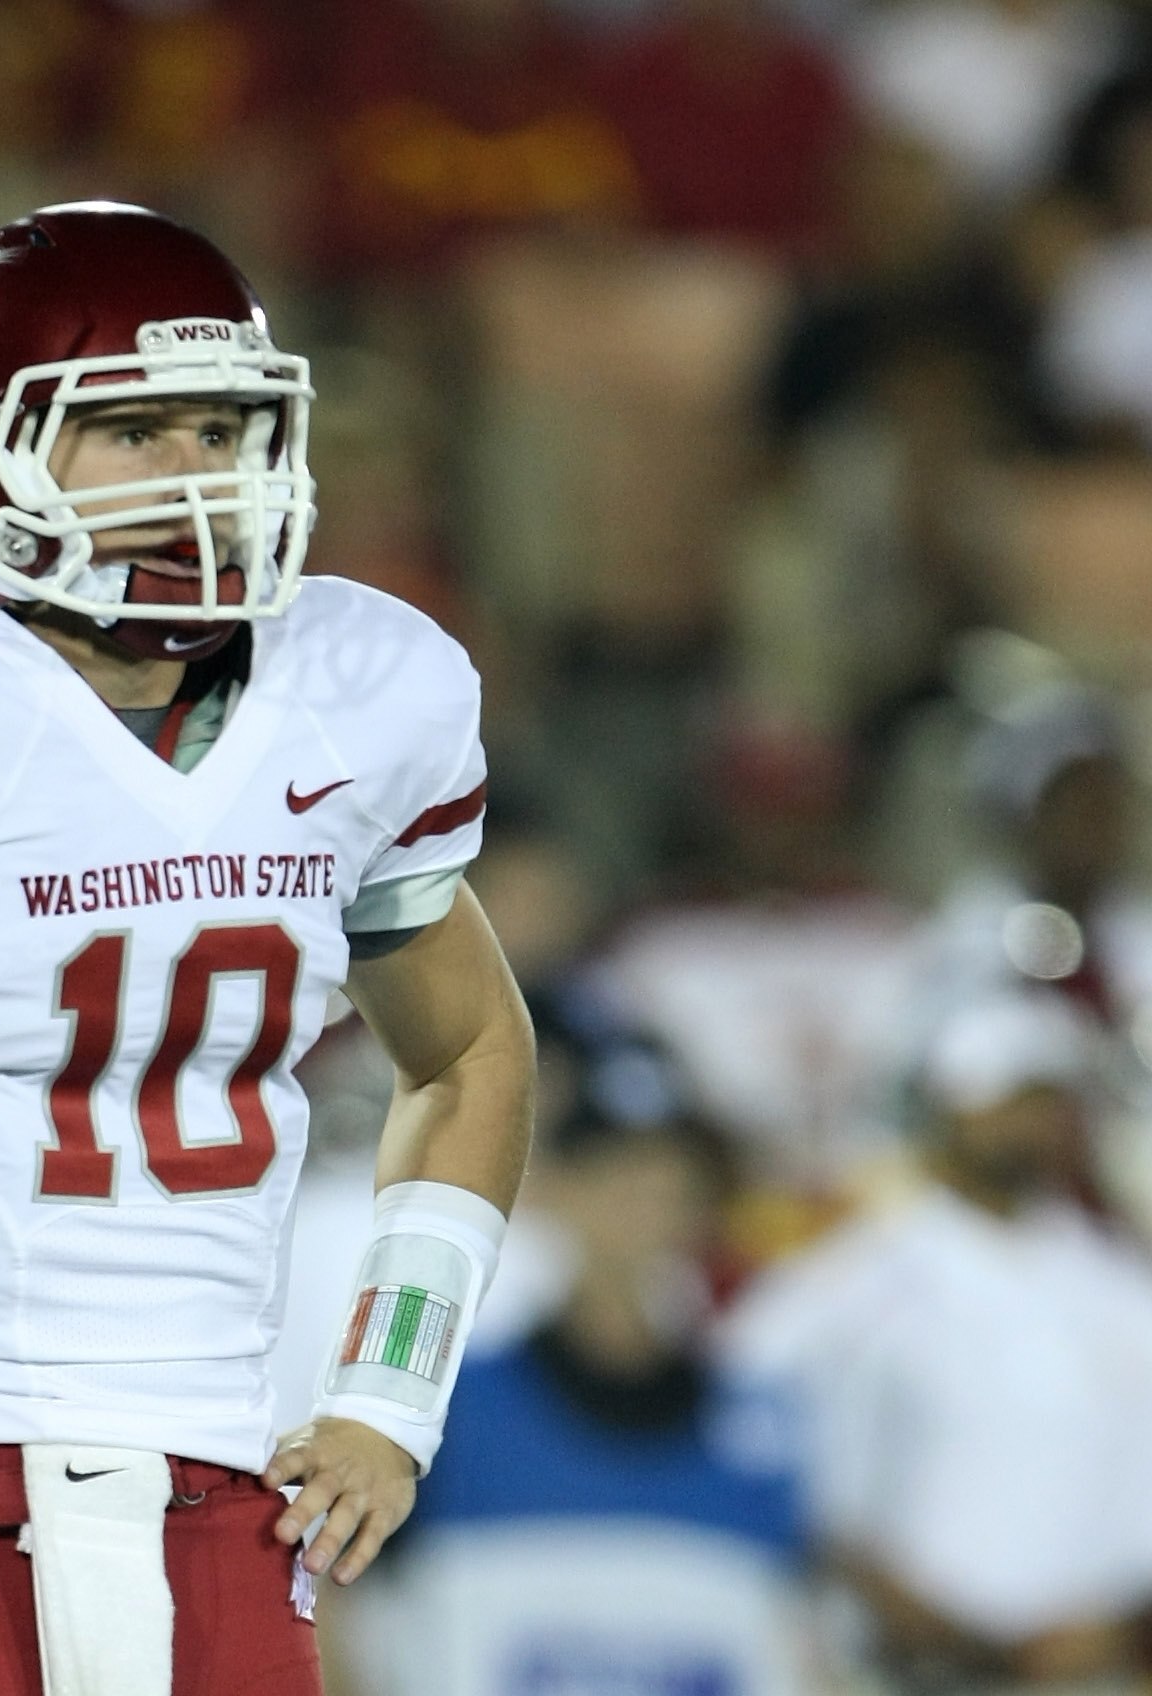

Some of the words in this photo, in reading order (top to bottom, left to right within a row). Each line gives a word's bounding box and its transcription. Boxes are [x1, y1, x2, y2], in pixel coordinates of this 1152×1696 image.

[173, 324, 231, 341] WSU
[20, 854, 246, 917] WASHINGTON
[256, 854, 335, 898] STATE
[32, 916, 306, 1207] 10
